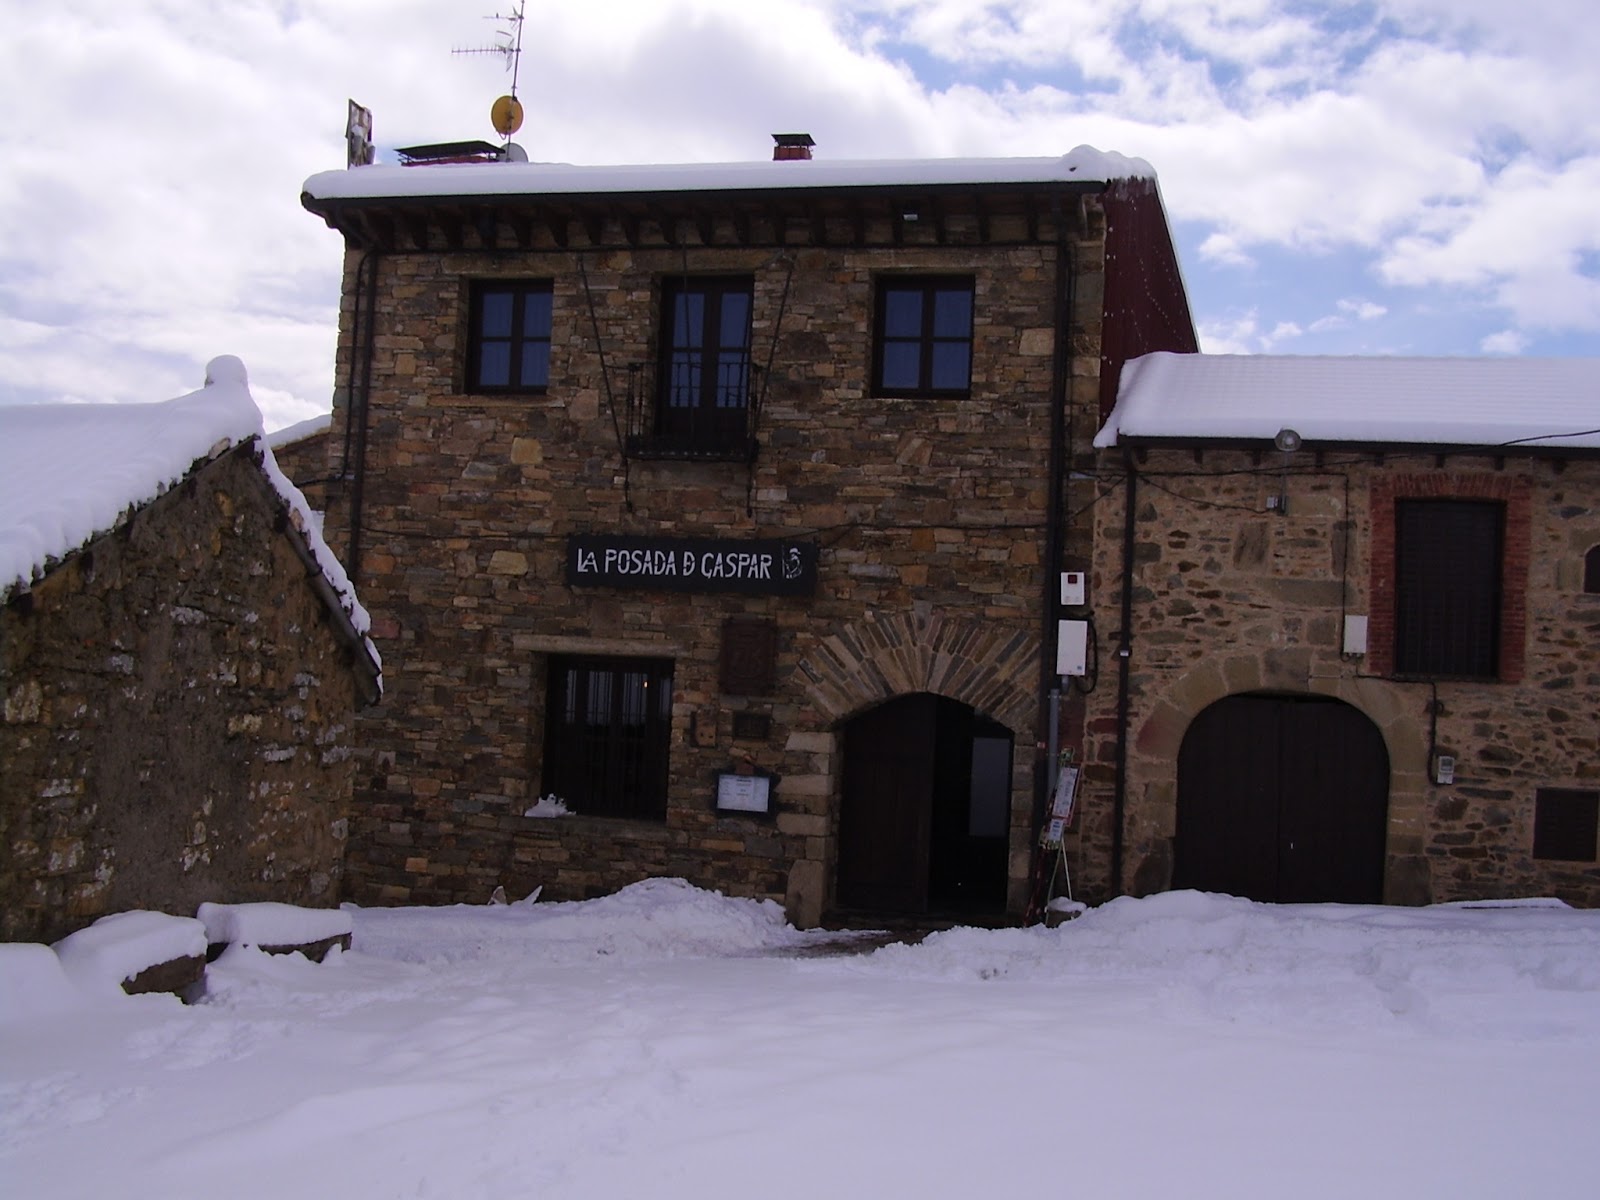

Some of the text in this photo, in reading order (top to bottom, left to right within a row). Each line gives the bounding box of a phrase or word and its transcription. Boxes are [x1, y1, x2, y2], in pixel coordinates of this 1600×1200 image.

[577, 548, 599, 573] LA
[604, 549, 677, 576] POSADA
[700, 552, 773, 580] GASPAR
